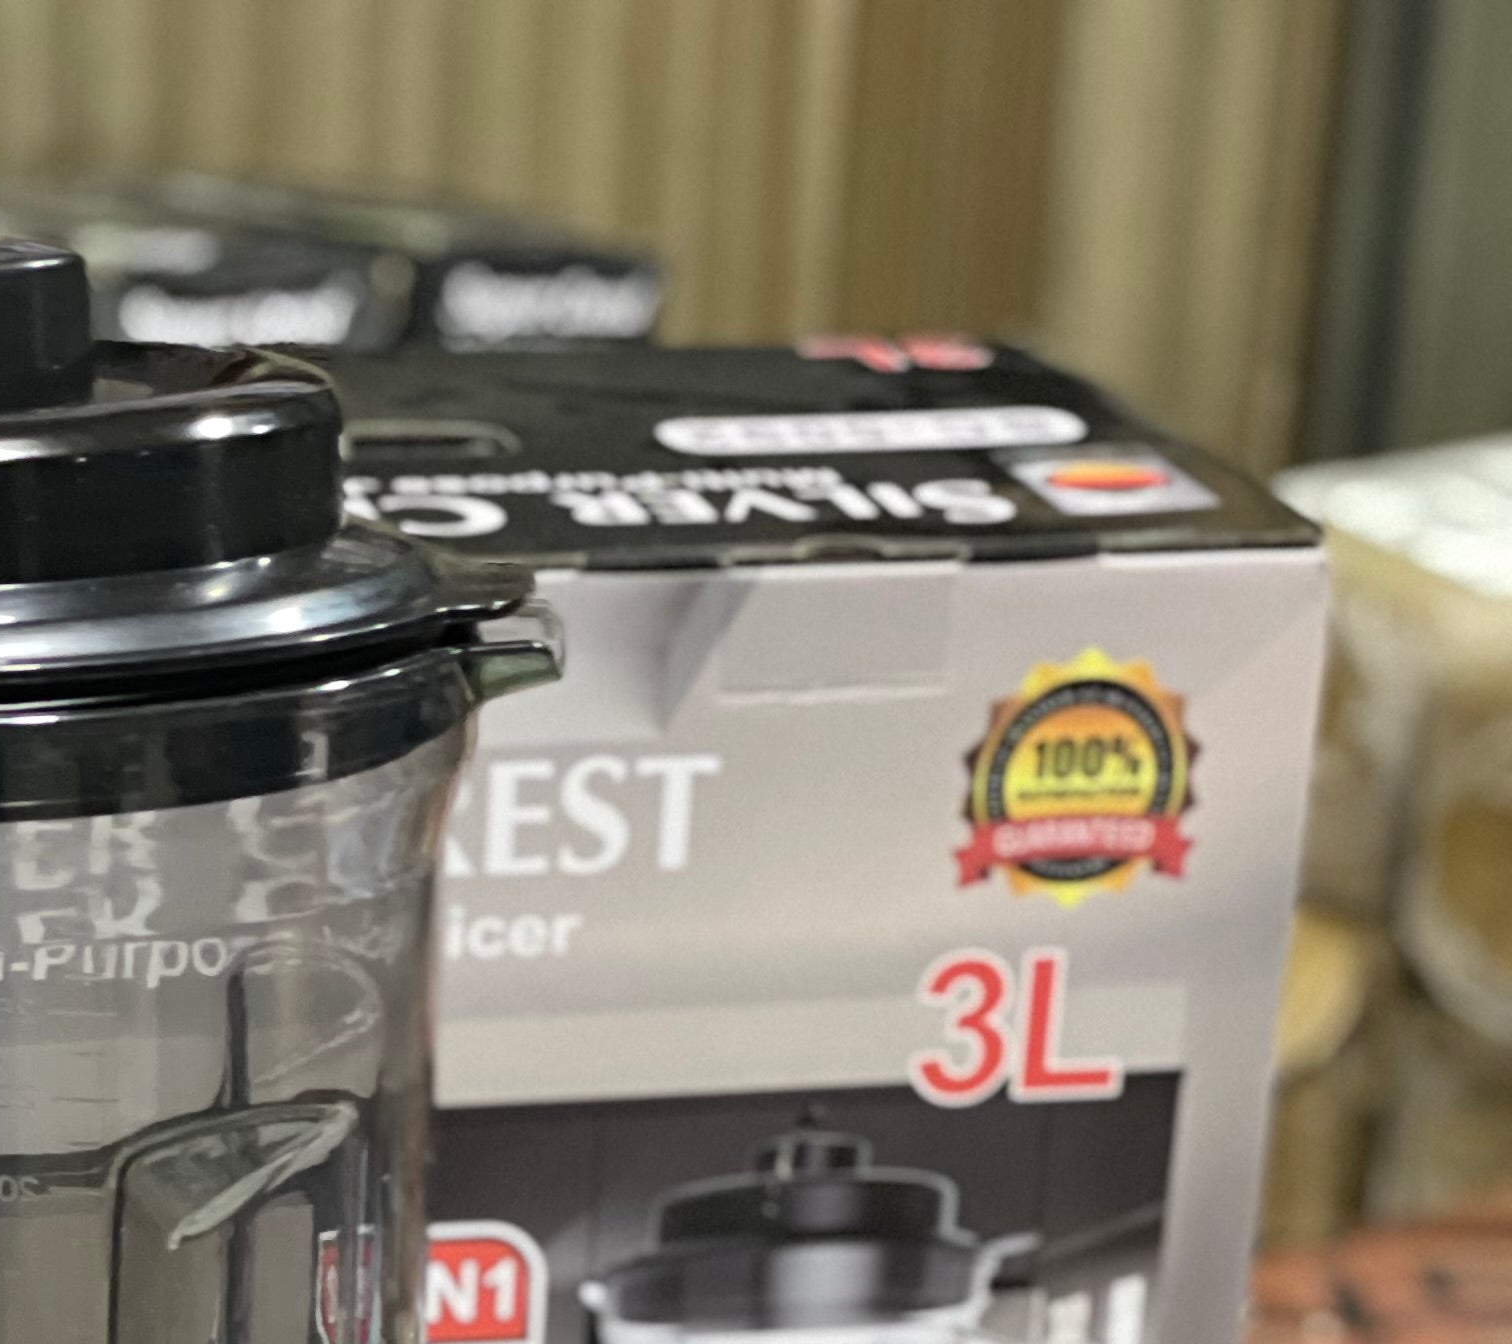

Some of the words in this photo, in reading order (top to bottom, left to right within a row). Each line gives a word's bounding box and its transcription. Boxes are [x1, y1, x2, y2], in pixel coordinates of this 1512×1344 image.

[1036, 735, 1142, 780] 100%
[444, 903, 583, 960] icer
[915, 953, 1122, 1102] 3L
